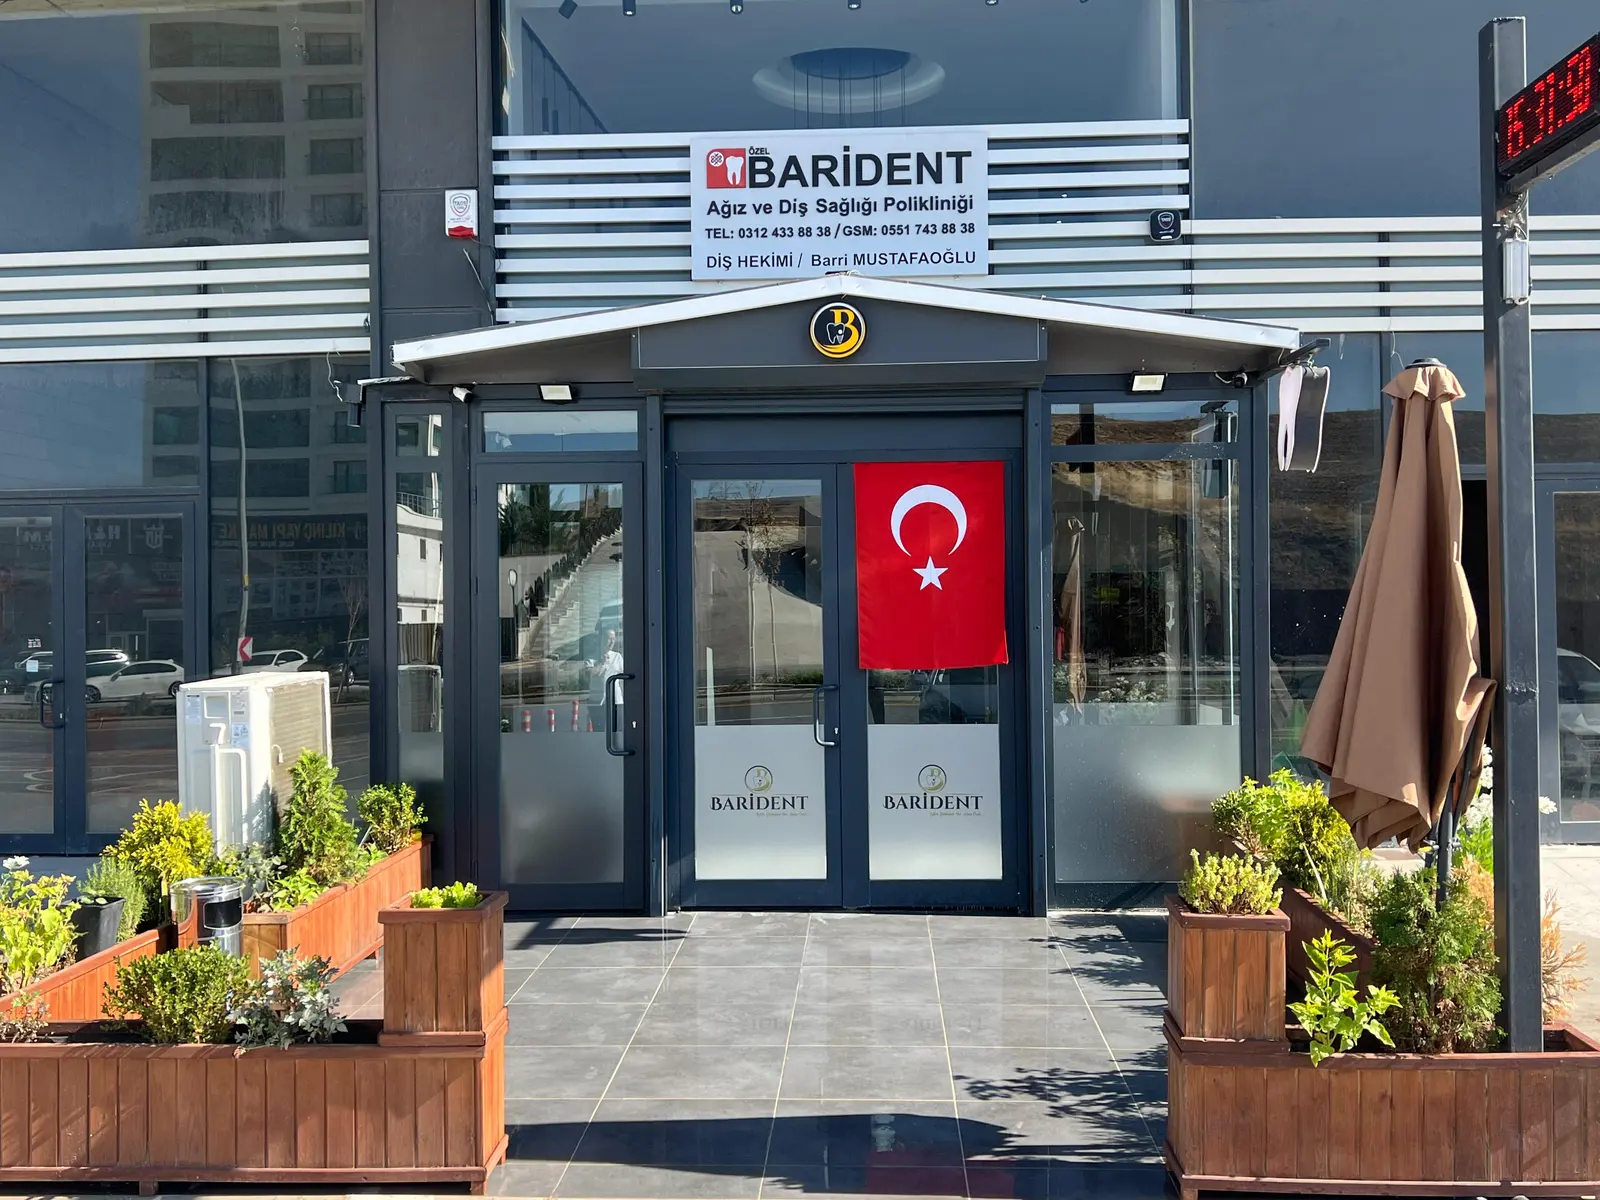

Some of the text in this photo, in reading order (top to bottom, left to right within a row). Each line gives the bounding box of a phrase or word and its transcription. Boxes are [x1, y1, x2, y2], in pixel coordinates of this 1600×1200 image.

[749, 146, 770, 155] ÖZEL
[749, 145, 972, 189] BARİDENT
[706, 194, 974, 219] Ağız ve Diş Sağlığı Polikliniği
[705, 222, 975, 239] TEL: 0312 433 88 38 / GSM: 0551 743 88 38
[706, 248, 976, 271] DİŞ HEKİMİ / Barri MUSTAFAOĞLU
[824, 308, 859, 353] B
[710, 793, 809, 811] BARİDENT
[883, 792, 984, 810] BARİDENT
